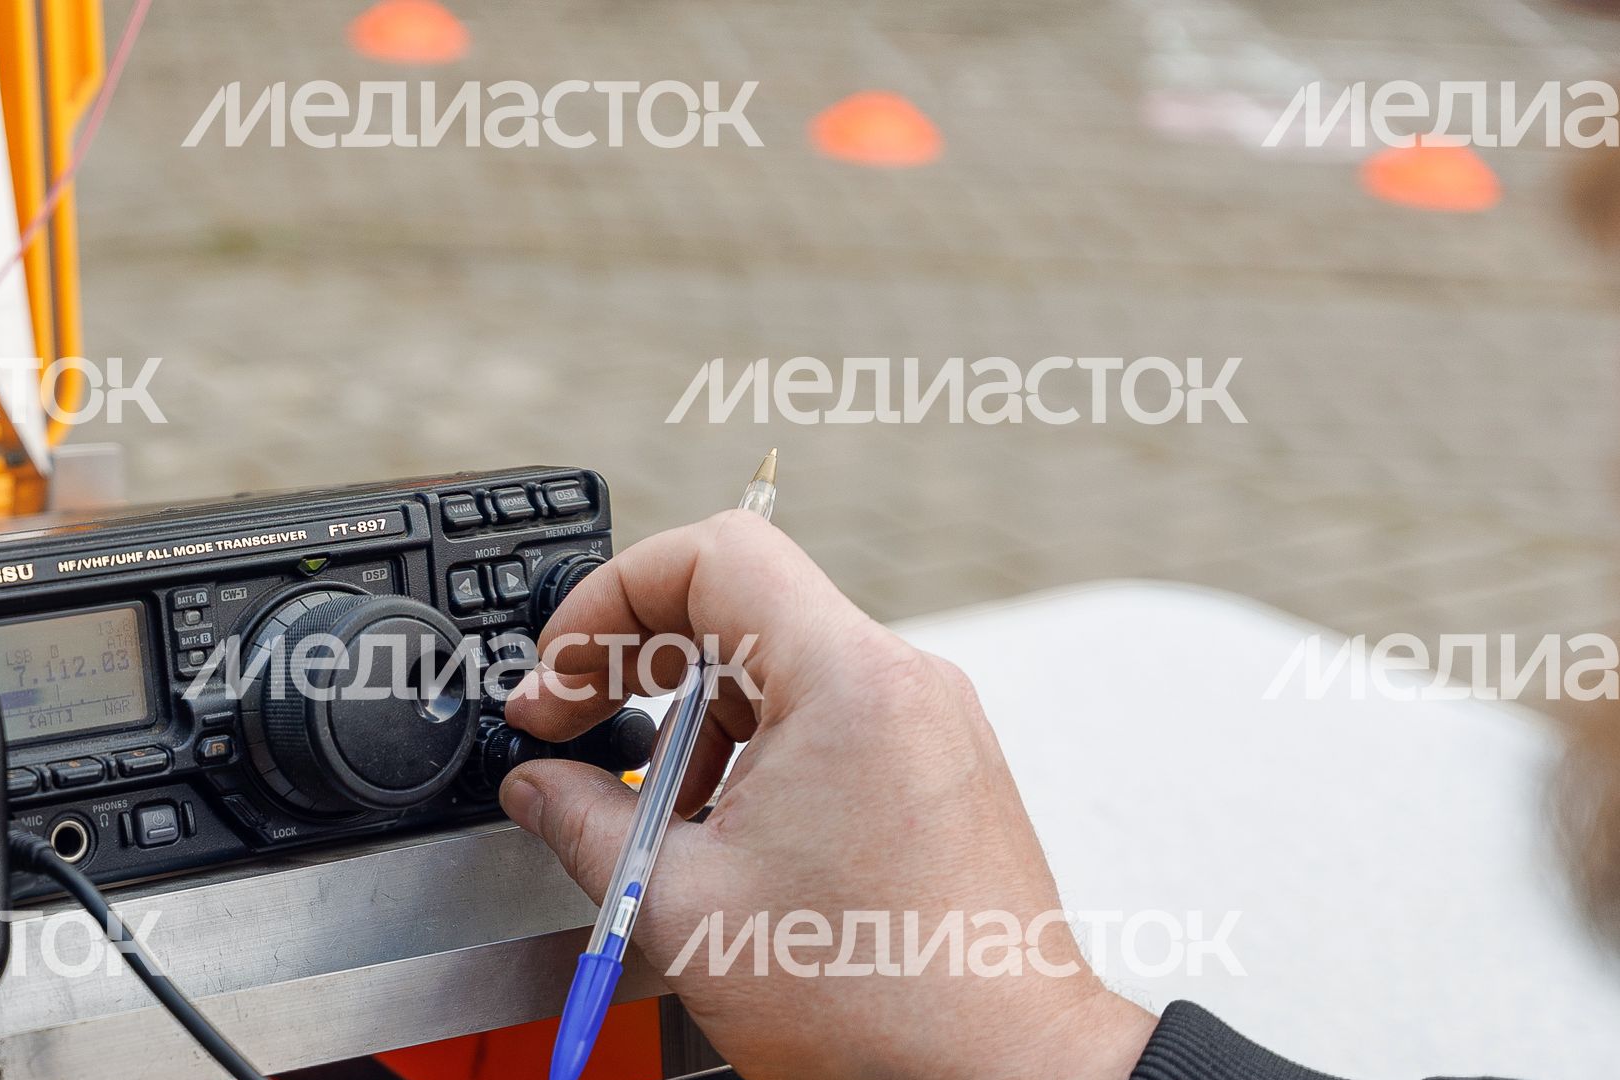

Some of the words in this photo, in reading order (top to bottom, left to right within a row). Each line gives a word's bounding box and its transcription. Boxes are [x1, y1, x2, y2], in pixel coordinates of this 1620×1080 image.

[557, 489, 577, 500] DSP
[451, 502, 472, 514] V/M
[501, 496, 527, 507] HOME
[545, 526, 582, 539] MEM/VFO
[582, 524, 593, 534] CH
[57, 550, 144, 574] HF/VHF/UHF
[146, 545, 171, 561] ALL
[172, 541, 213, 558] MODE
[215, 529, 307, 552] TRANSCEIVER
[328, 517, 387, 538] FT-897
[475, 546, 501, 559] MODE
[524, 548, 542, 558] DWN
[364, 568, 387, 581] DSP
[222, 588, 247, 601] CW-T
[482, 613, 508, 625] BAND
[6, 650, 33, 667] LSB
[13, 650, 130, 687] 7.112.03
[92, 800, 128, 814] PHONES
[273, 827, 298, 839] LOCK
